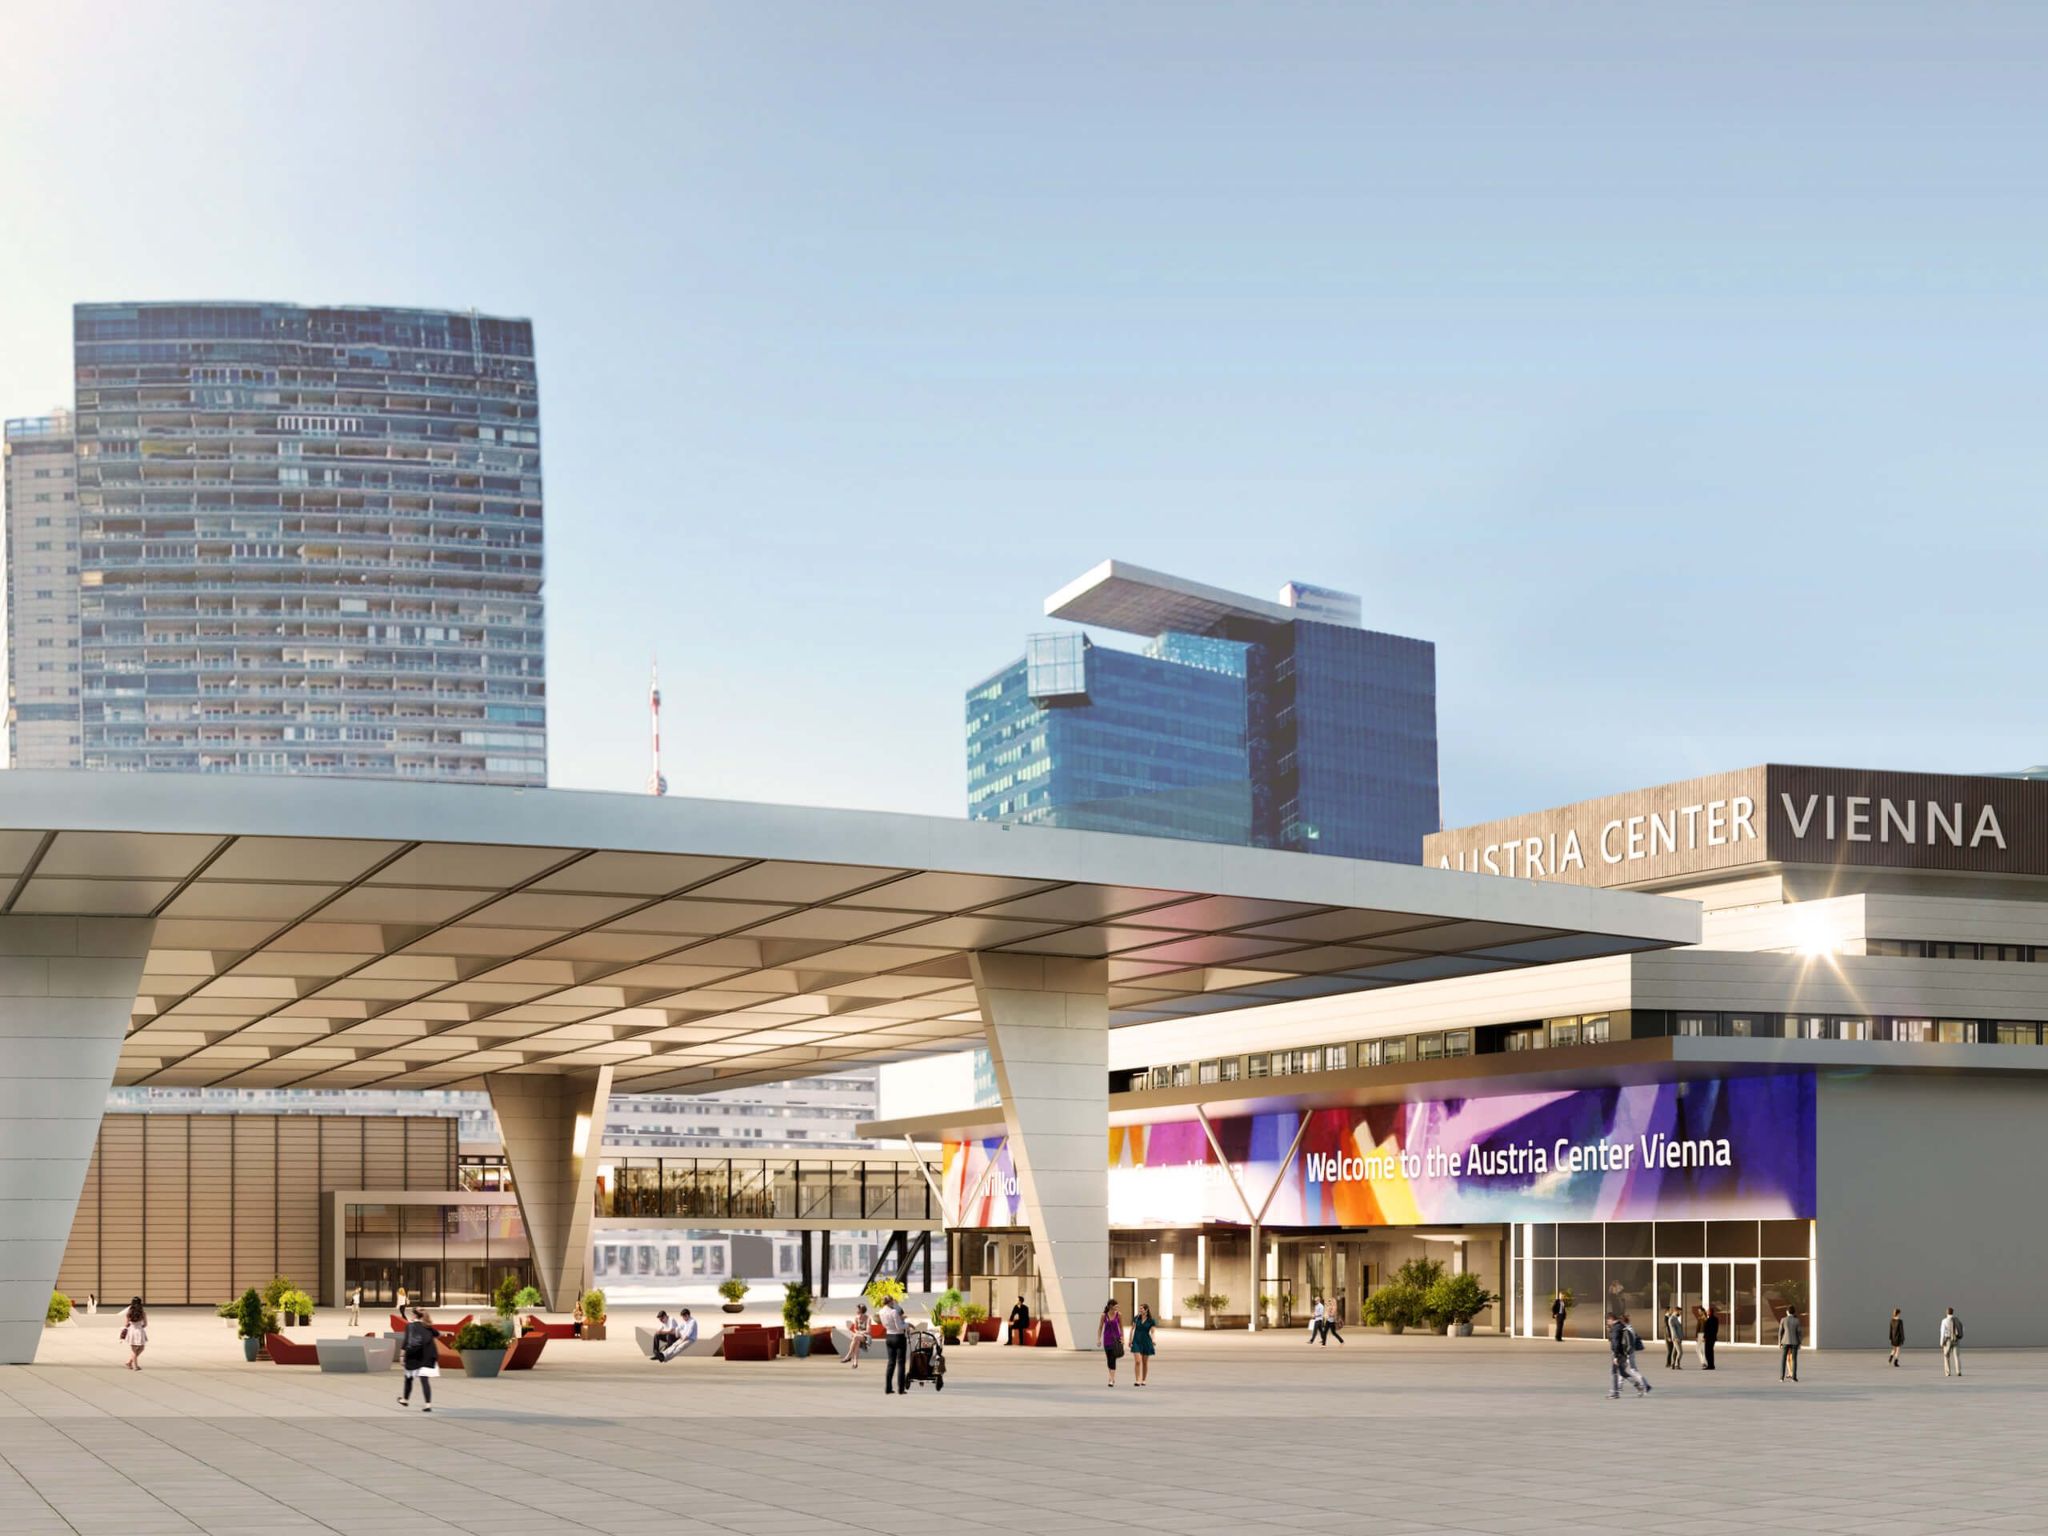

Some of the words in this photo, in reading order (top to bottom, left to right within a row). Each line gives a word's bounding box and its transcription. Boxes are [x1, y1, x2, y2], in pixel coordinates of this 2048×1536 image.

[1601, 796, 1758, 864] CENTER
[1781, 793, 2007, 849] VIENNA
[977, 1171, 1020, 1197] Willko
[1307, 1150, 1395, 1183] Welcome
[1400, 1149, 1421, 1179] to
[1427, 1145, 1461, 1178] the
[1467, 1140, 1547, 1176] Austria
[1554, 1138, 1634, 1172] Center
[1641, 1133, 1731, 1169] Vienna
